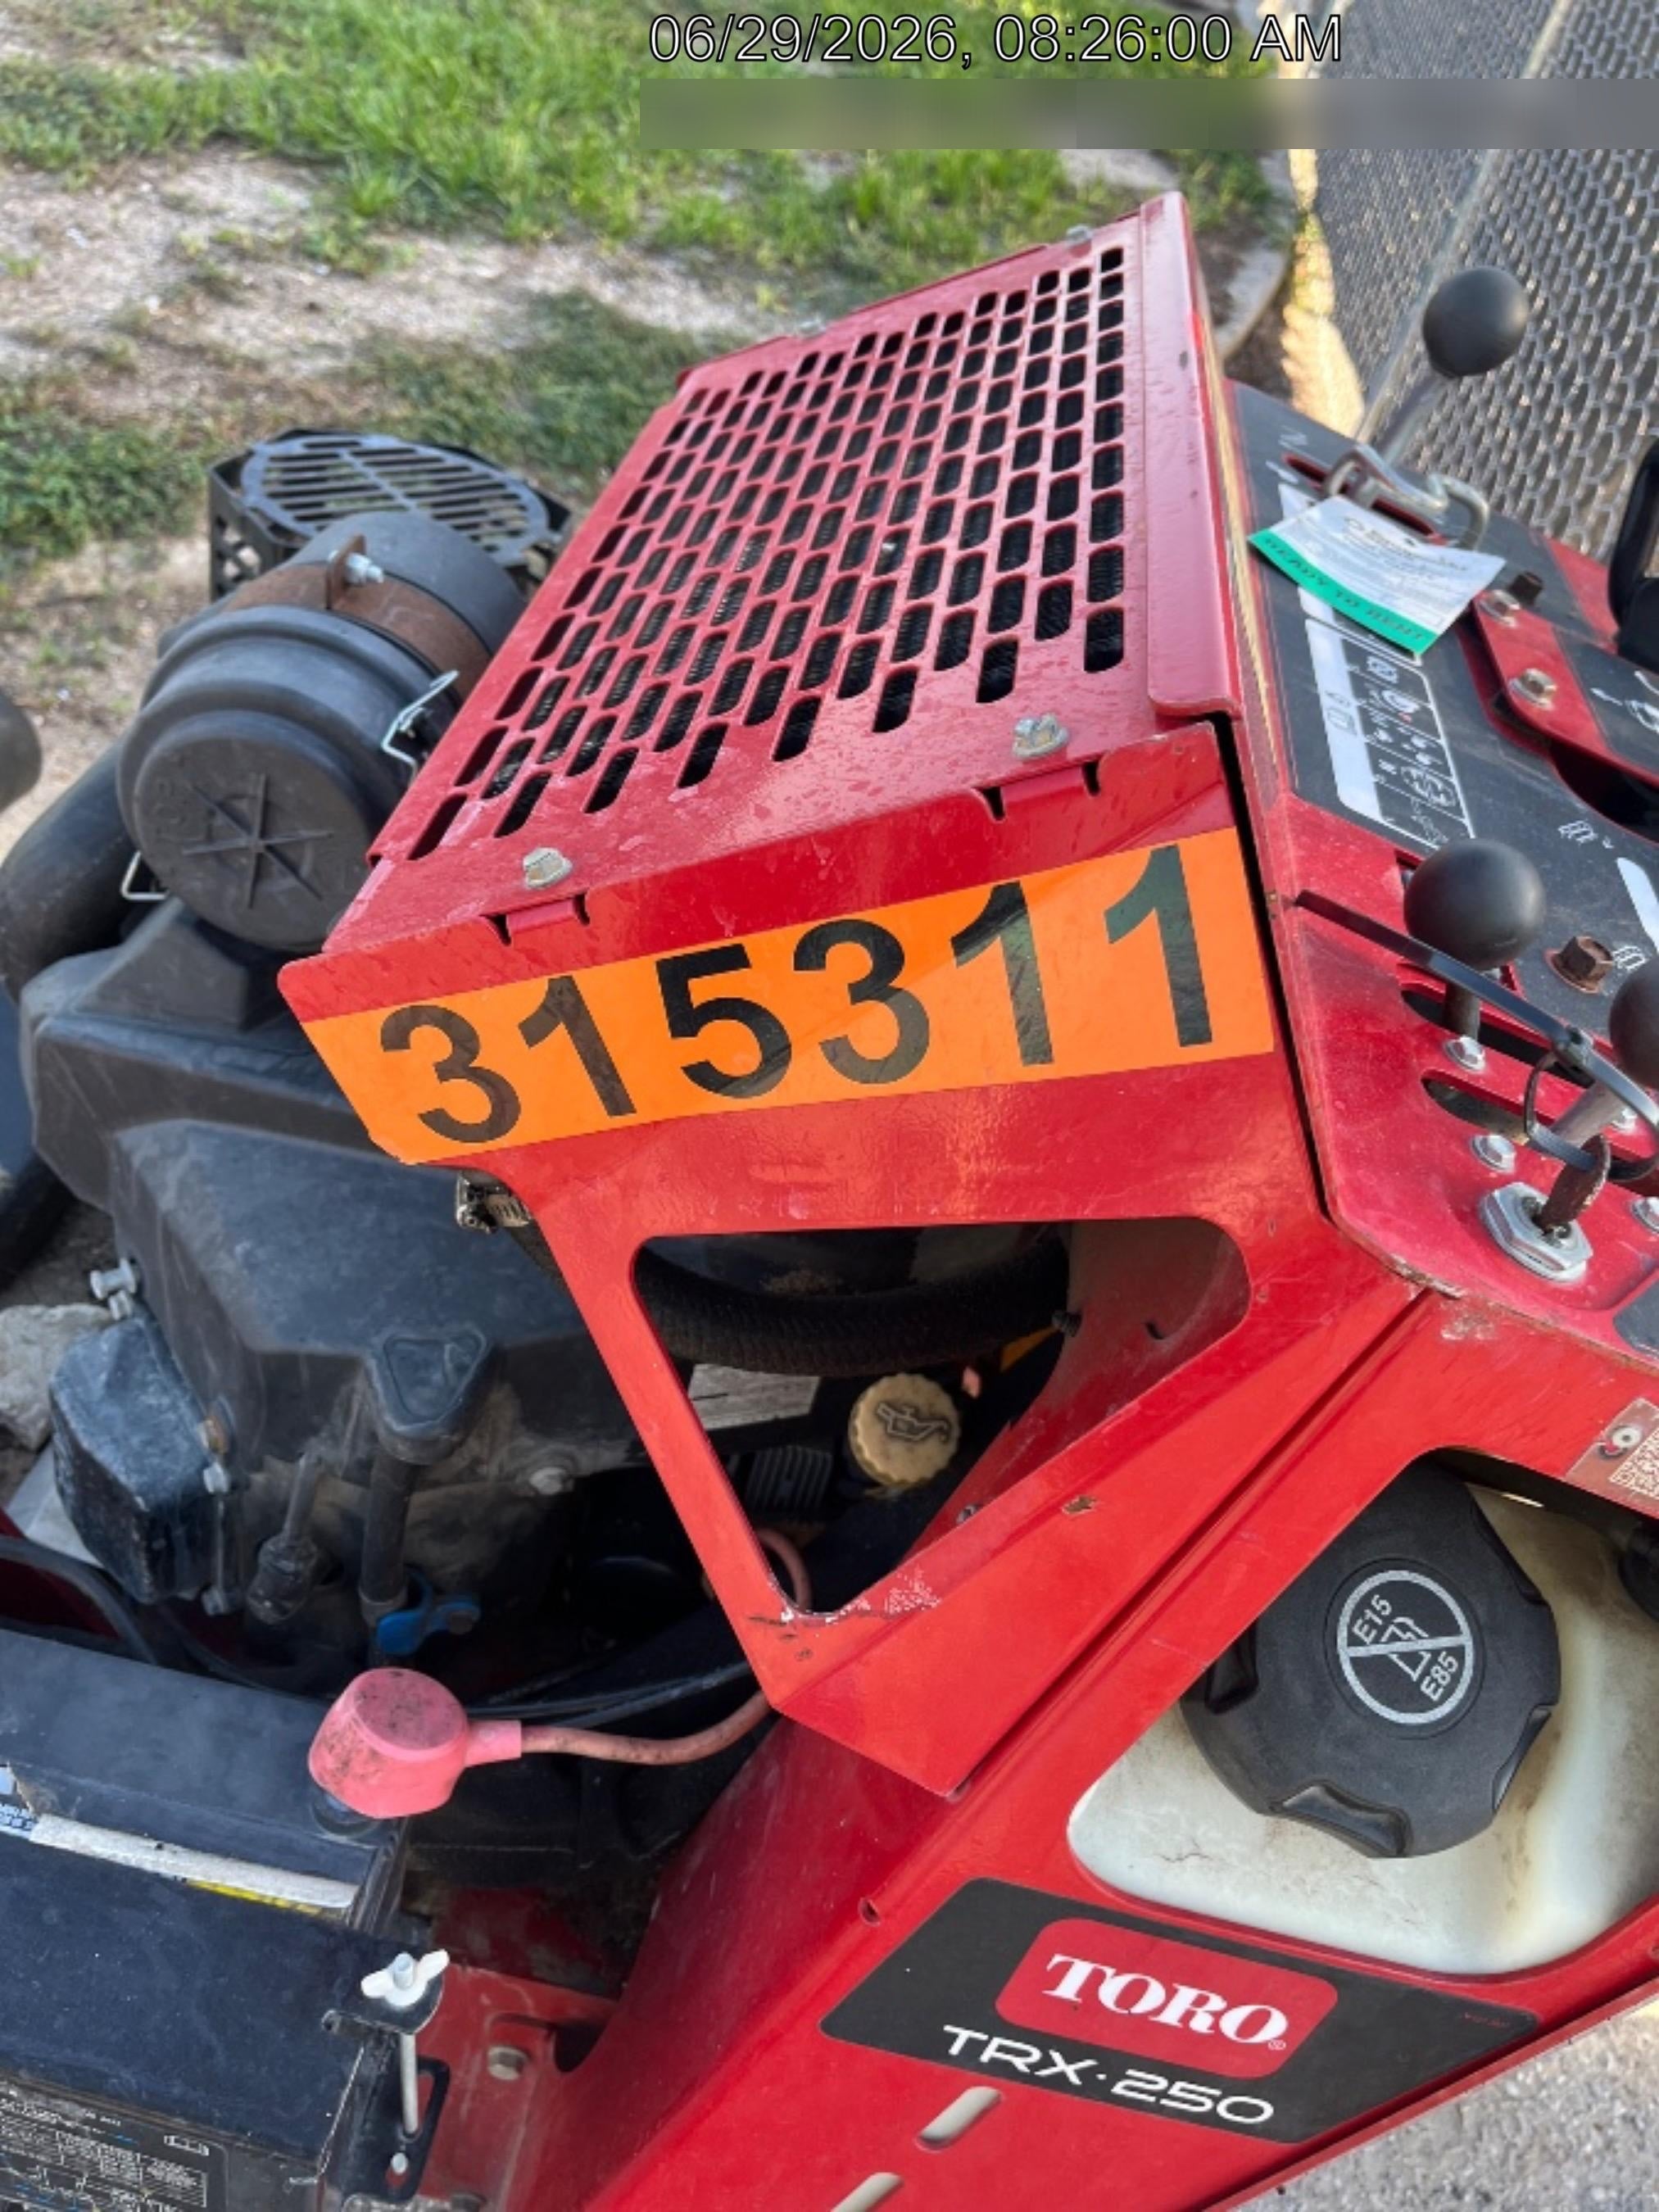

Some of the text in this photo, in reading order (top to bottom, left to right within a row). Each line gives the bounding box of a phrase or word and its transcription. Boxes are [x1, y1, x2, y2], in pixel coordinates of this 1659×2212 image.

[381, 845, 1213, 1144] 315311
[1352, 1593, 1392, 1645] E15
[1420, 1650, 1459, 1702] E85
